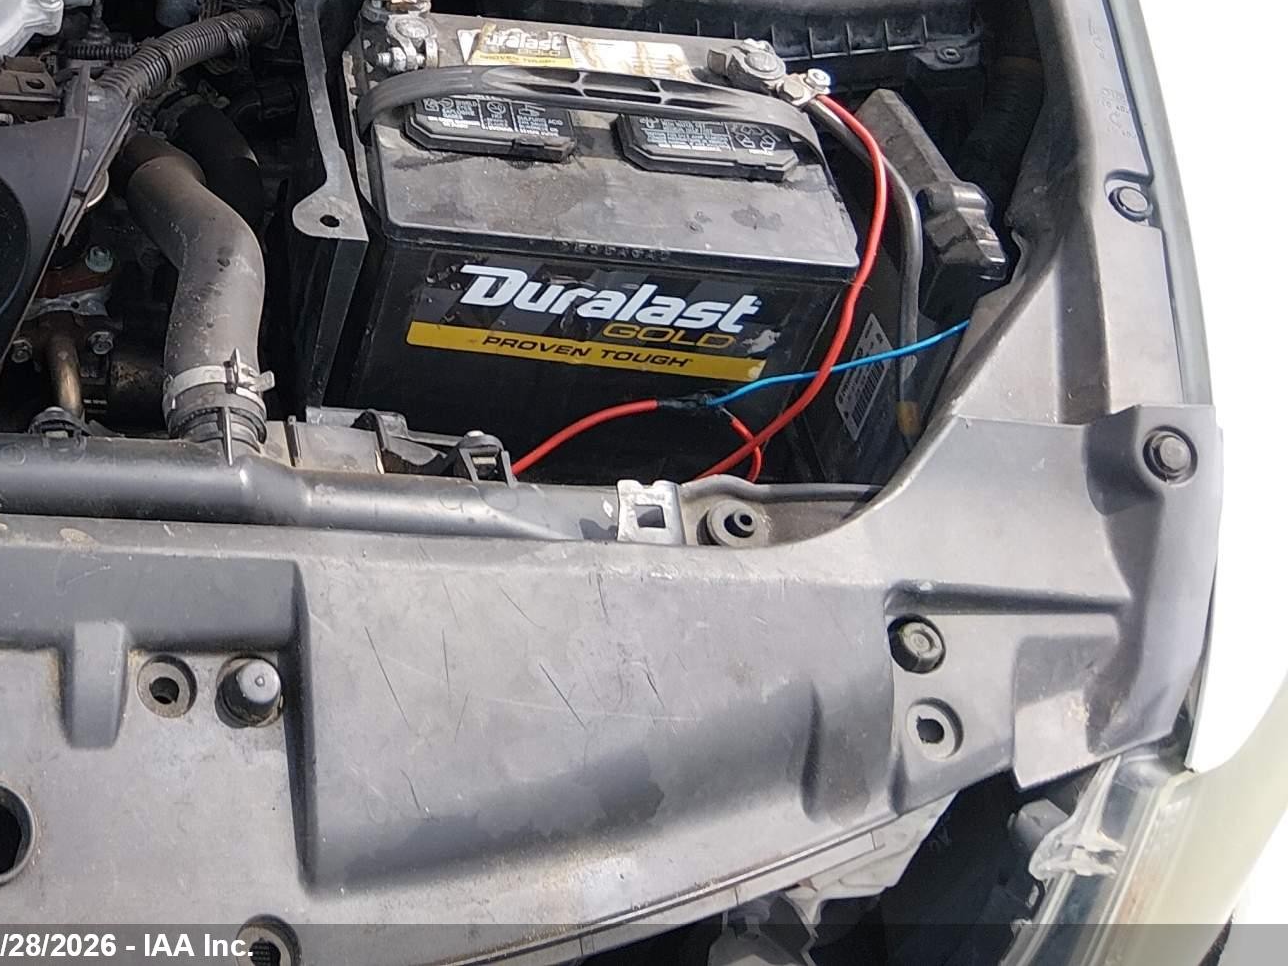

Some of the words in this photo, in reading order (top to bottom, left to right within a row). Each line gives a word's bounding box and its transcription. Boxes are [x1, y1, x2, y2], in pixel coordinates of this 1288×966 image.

[459, 264, 759, 334] Duralast
[603, 322, 736, 349] GOLD
[481, 336, 592, 358] PROVEN
[600, 349, 689, 368] TOUGH
